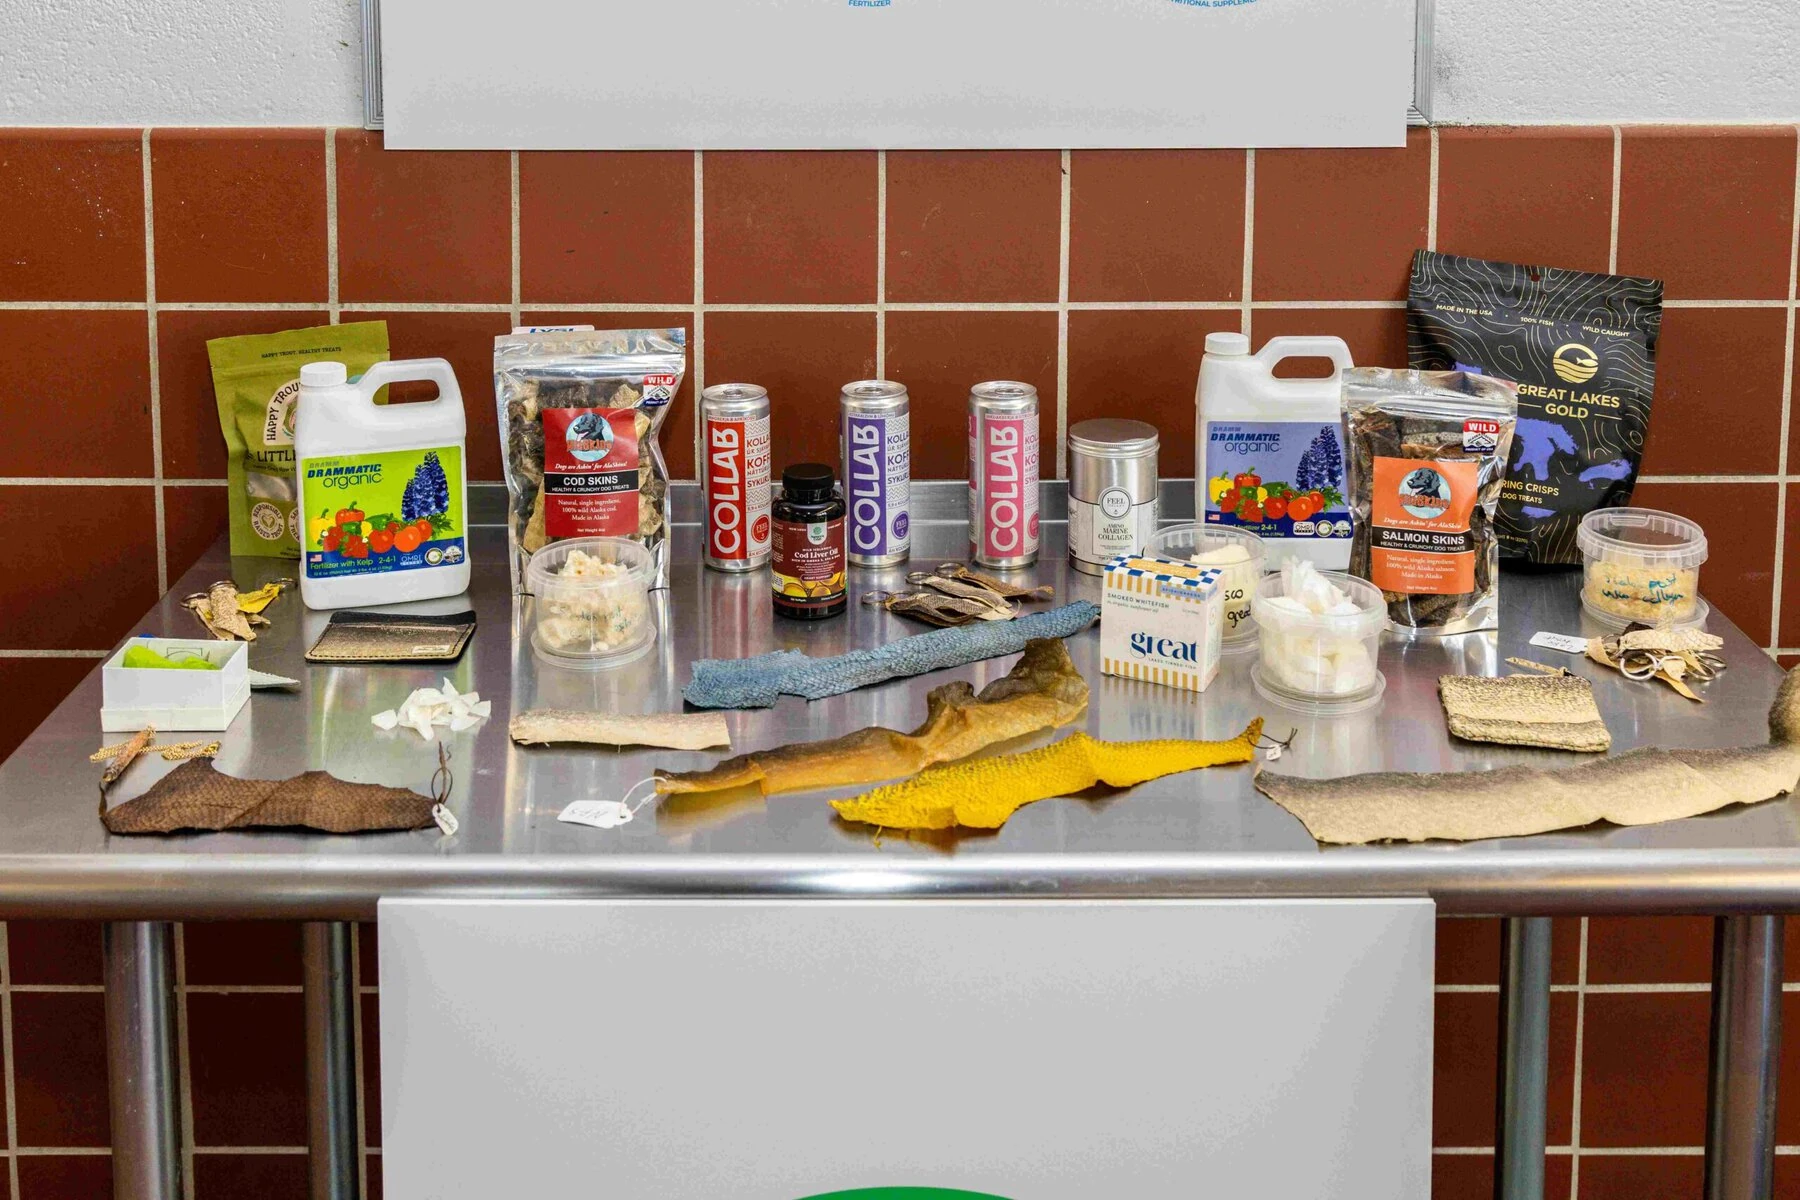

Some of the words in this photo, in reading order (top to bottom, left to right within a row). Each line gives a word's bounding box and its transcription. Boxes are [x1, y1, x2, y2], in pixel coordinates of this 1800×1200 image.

[1436, 304, 1455, 312] MADE
[1465, 307, 1478, 315] THE
[1520, 316, 1537, 324] 100%
[1538, 319, 1554, 327] FISH
[1582, 325, 1600, 334] WILD
[1600, 328, 1630, 338] CAUGHT
[647, 376, 673, 384] WILD
[1518, 383, 1567, 401] GREAT
[1570, 390, 1620, 408] LAKES
[267, 407, 279, 440] HAPPY
[274, 382, 300, 404] TROU
[1545, 403, 1588, 419] GOLD
[1468, 422, 1497, 432] WILD
[1210, 433, 1280, 441] DRAMMATIC
[1224, 442, 1280, 455] organic
[307, 464, 382, 478] DRAMMATIC
[323, 473, 382, 489] organic
[563, 477, 585, 486] COD
[587, 475, 618, 485] SKINS
[852, 424, 881, 550] COLLAB
[712, 427, 741, 554] COLLAB
[990, 426, 1018, 552] COLLAB
[1525, 483, 1559, 496] CRISPS
[1502, 492, 1517, 500] DOG
[1518, 494, 1542, 504] TREATS
[1382, 531, 1429, 543] SALMON
[1432, 535, 1464, 544] SKINS
[829, 547, 838, 555] Oil
[310, 562, 339, 570] Fertilizer
[356, 559, 373, 567] Kelp
[378, 556, 396, 564] 2-4-1
[1107, 593, 1133, 602] SMOKED
[1135, 598, 1169, 608] WHITEFISH
[1130, 632, 1199, 663] great
